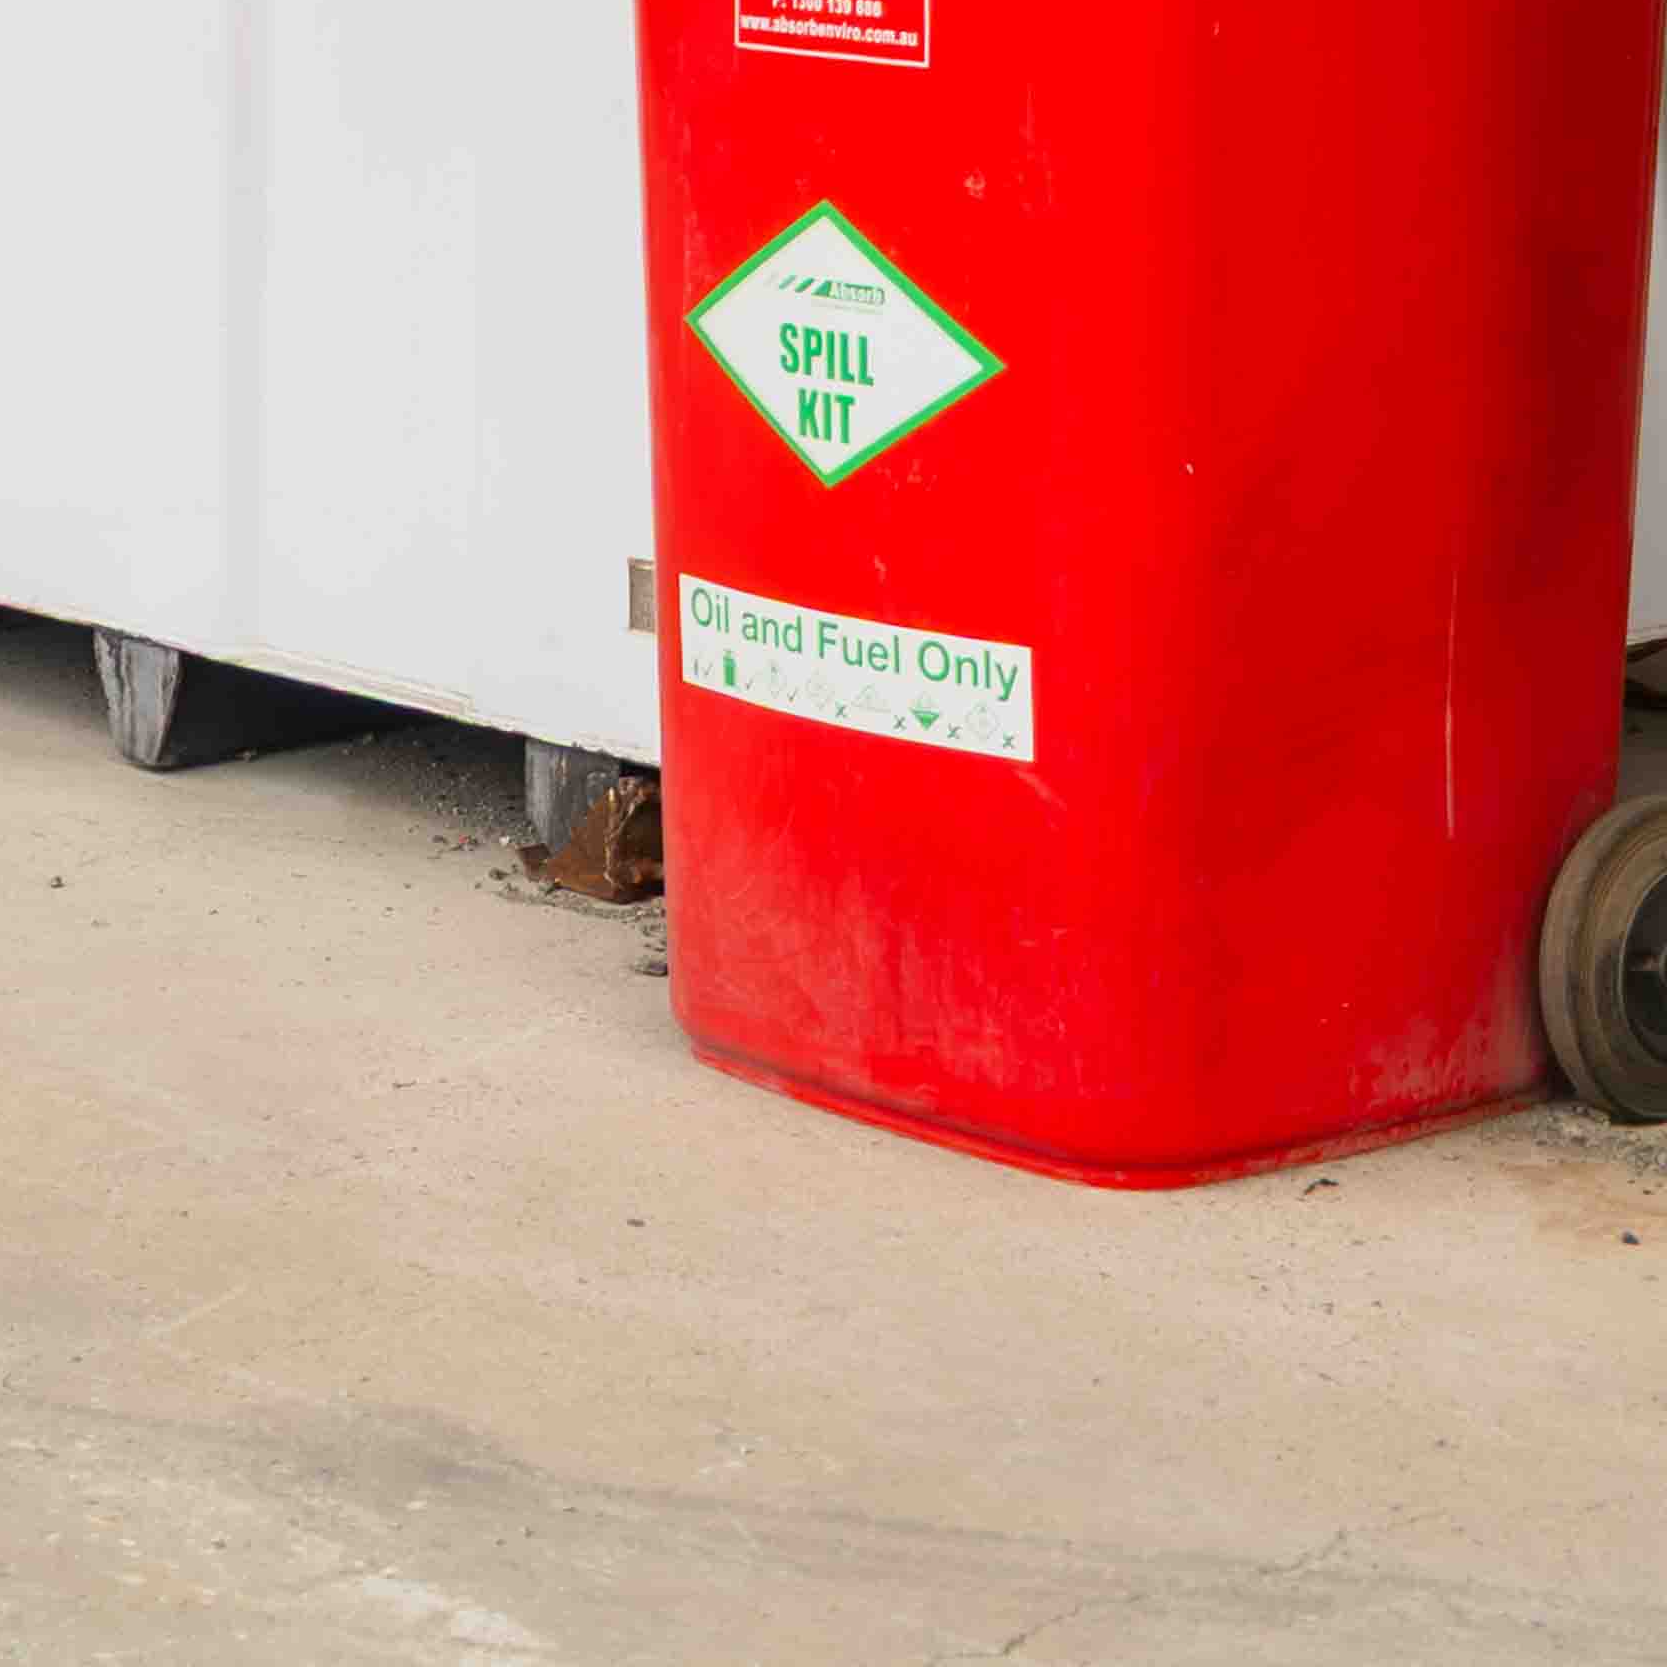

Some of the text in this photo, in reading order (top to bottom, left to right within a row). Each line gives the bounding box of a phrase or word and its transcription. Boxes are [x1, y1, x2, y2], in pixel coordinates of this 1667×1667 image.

[779, 322, 874, 387] SPILL
[798, 389, 855, 444] KIT
[690, 587, 1018, 702] Oil and Fuel Only
